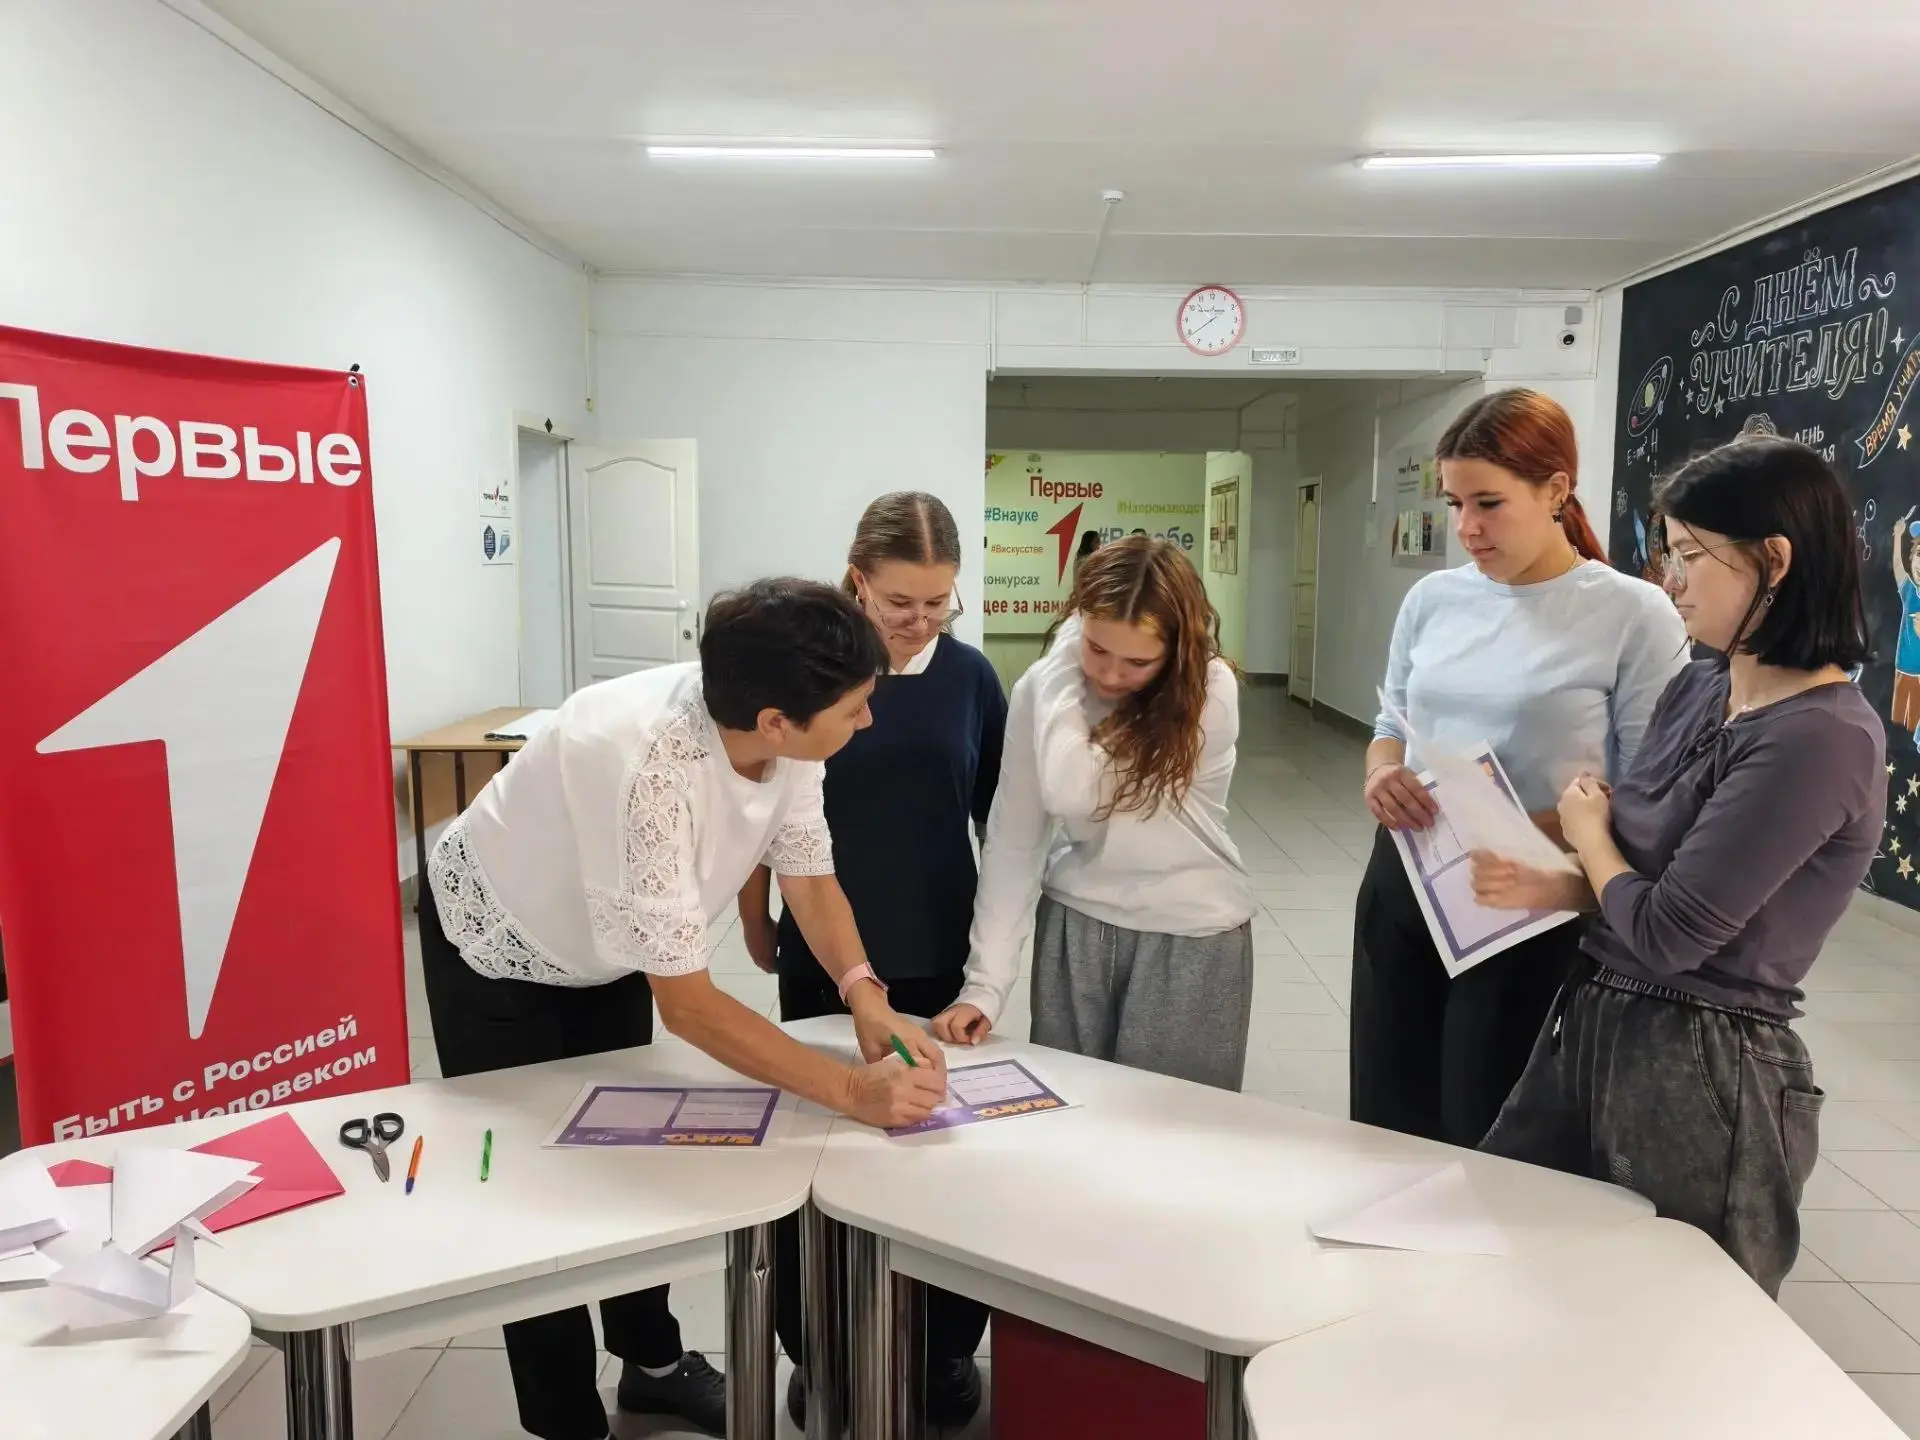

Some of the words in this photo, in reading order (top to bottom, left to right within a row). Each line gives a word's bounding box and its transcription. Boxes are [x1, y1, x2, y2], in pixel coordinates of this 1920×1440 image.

[1718, 285, 1740, 343] С
[1745, 247, 1858, 341] ДНЁМ
[1690, 307, 1889, 415] УЧИТЕЛЯ!
[1865, 400, 1898, 457] ВРЕМЯ
[984, 507, 1039, 526] #Внауке
[1029, 475, 1104, 503] Первые
[991, 544, 1044, 556] #Вискусстве
[1013, 600, 1028, 614] за
[52, 1094, 164, 1143] Быть
[173, 1080, 195, 1102] с
[204, 1014, 358, 1092] Россией
[175, 1046, 376, 1124] ловеком
